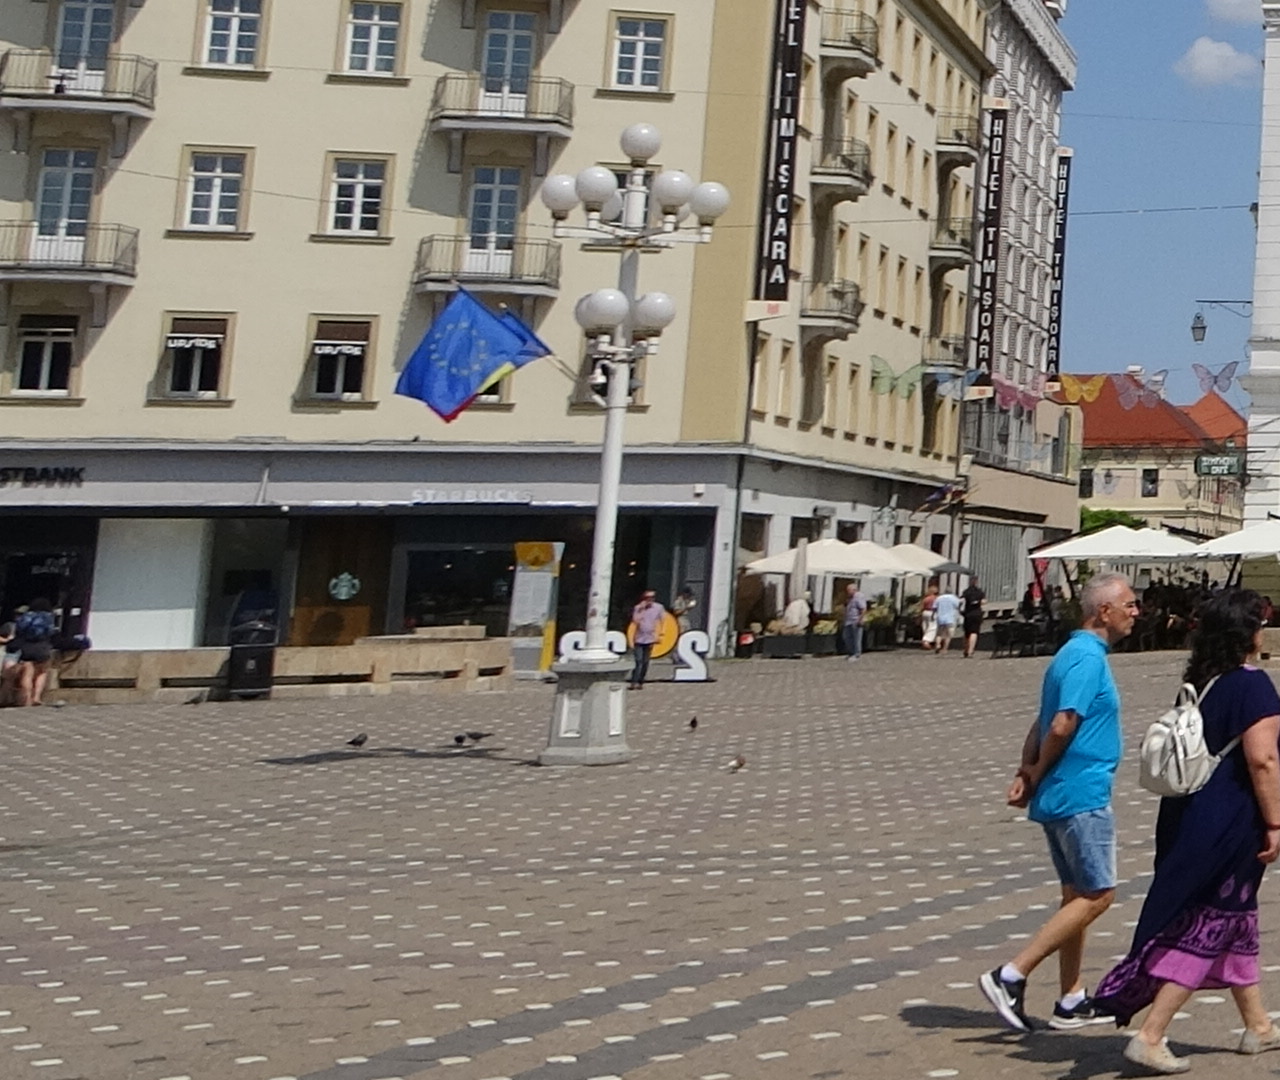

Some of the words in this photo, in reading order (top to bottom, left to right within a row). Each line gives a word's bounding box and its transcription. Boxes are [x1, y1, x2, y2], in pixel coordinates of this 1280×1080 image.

[988, 119, 1004, 210] HOTEL
[1055, 164, 1068, 239] HOTEL
[411, 488, 533, 503] STARBUCKS
